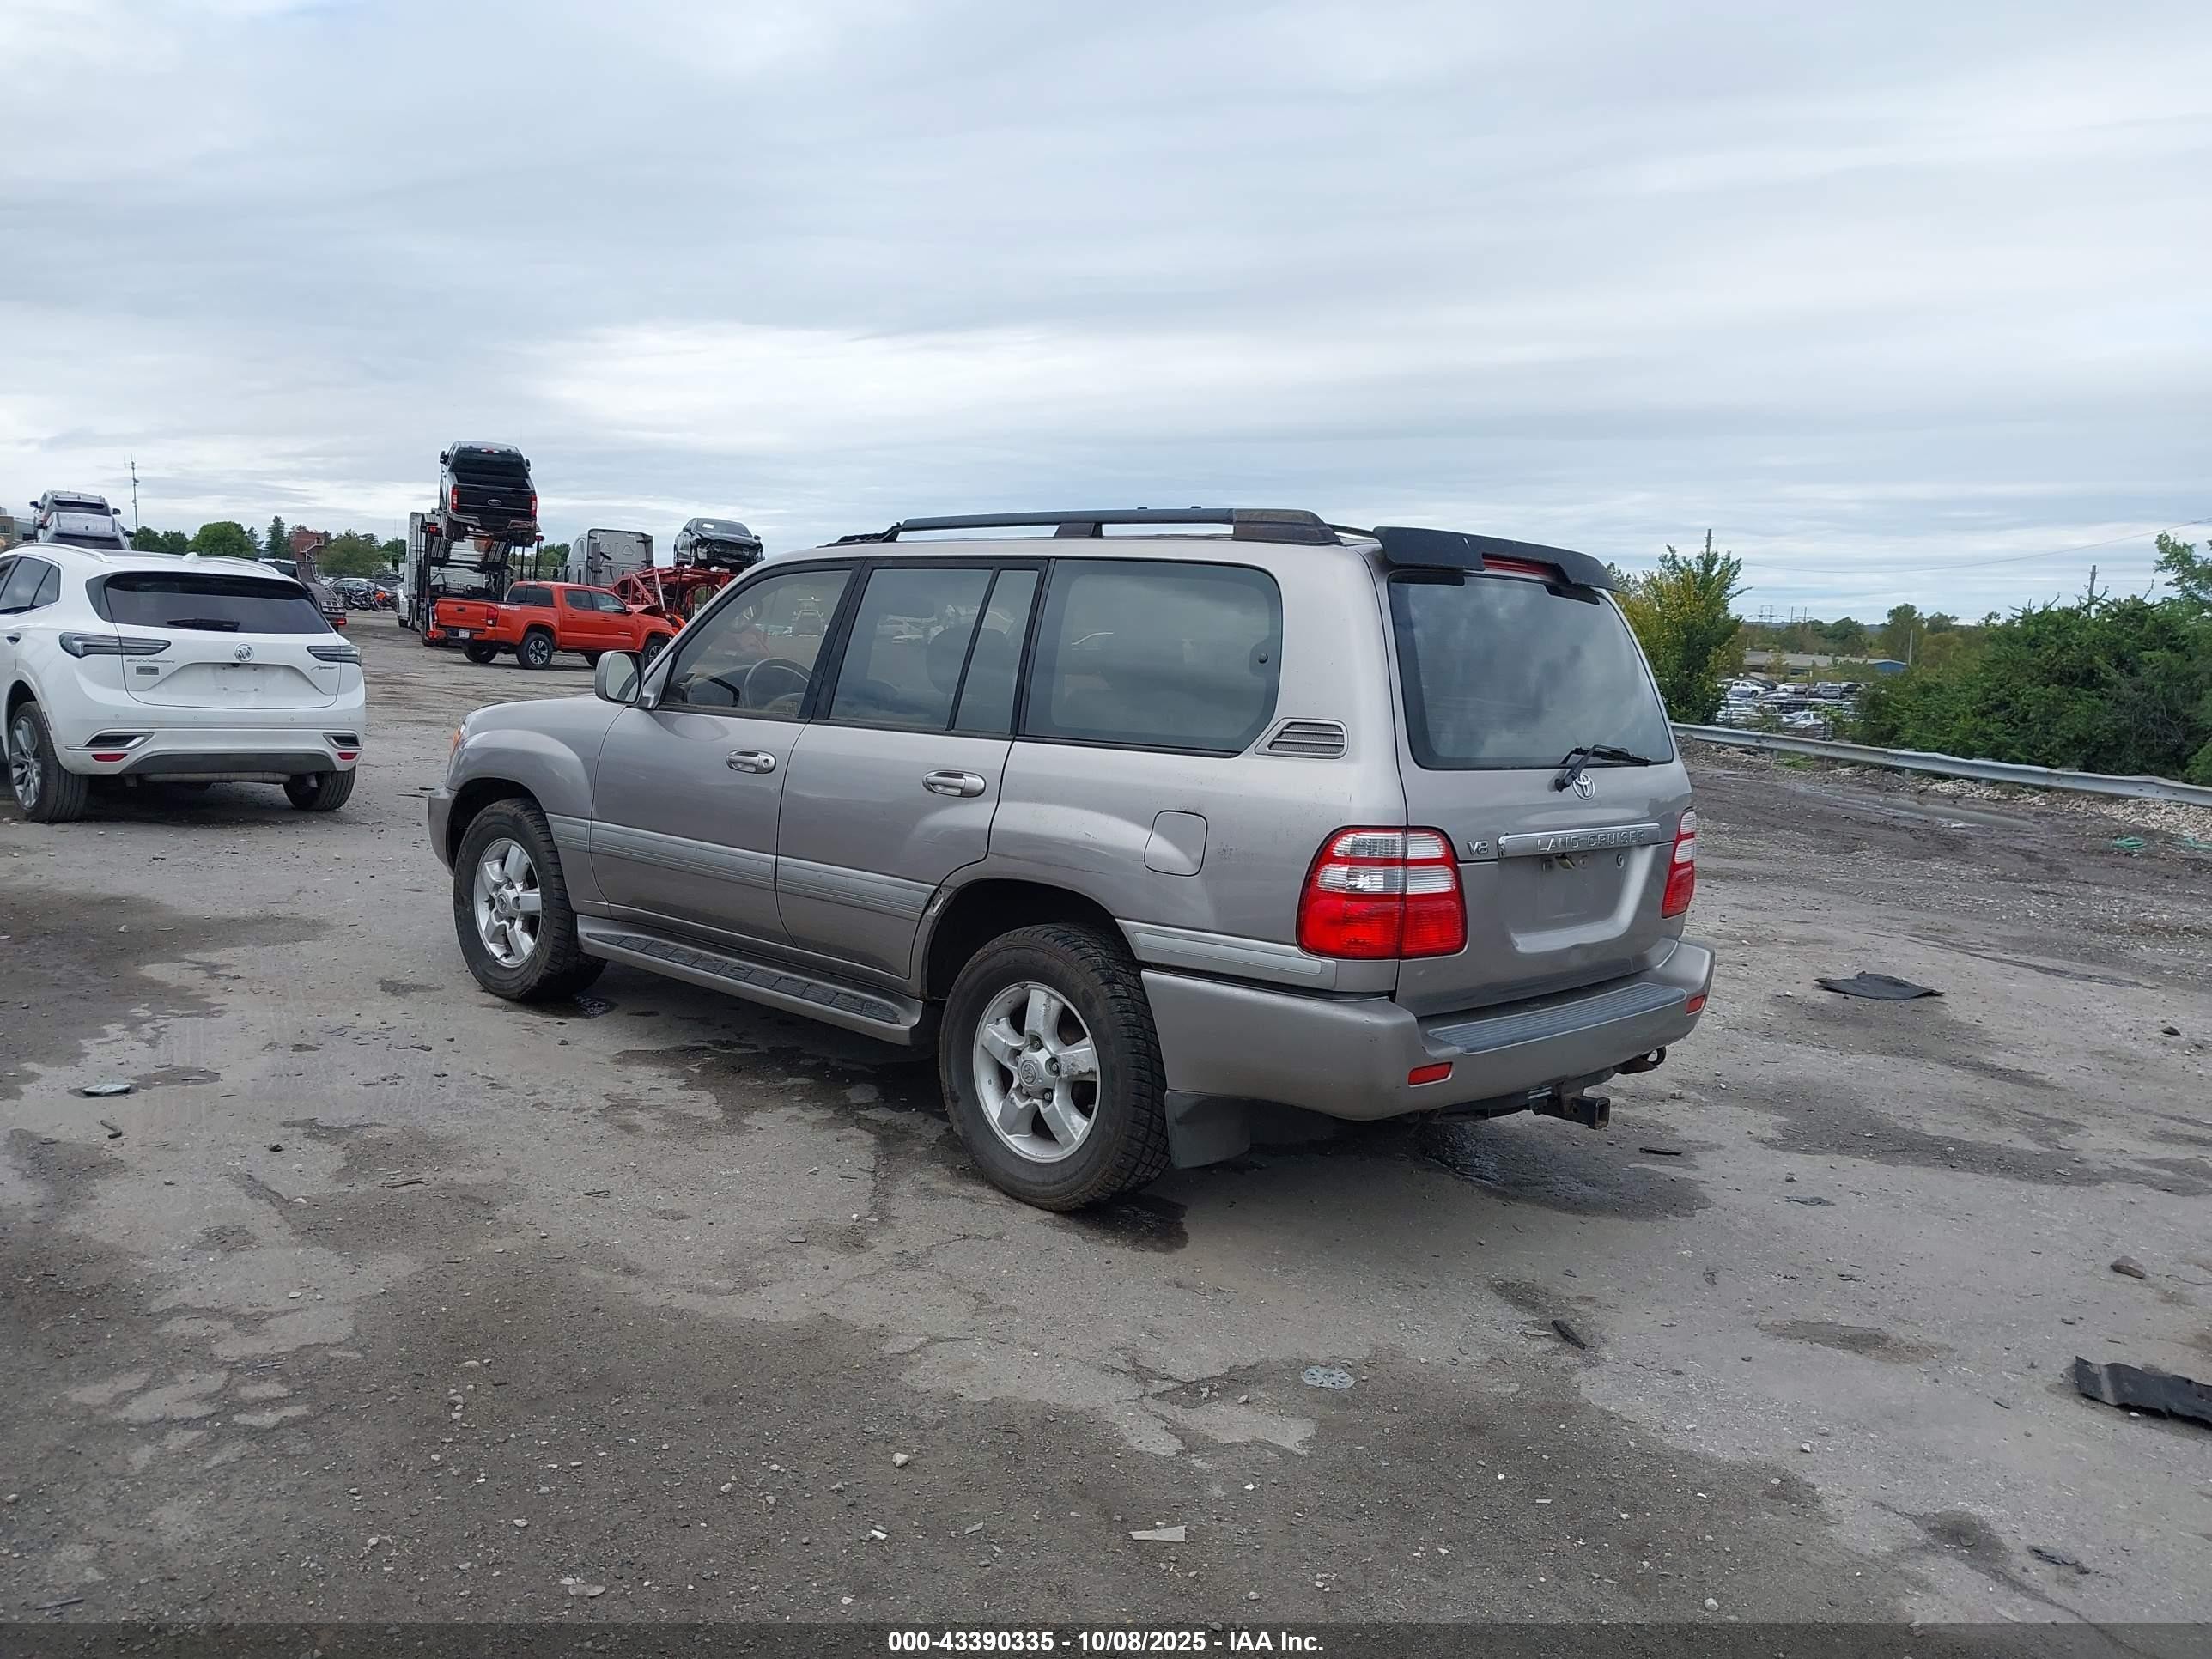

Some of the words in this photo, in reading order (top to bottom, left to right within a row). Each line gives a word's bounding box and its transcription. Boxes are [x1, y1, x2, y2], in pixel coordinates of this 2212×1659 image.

[1467, 840, 1489, 855] V8
[1537, 835, 1580, 852] LAND
[1588, 830, 1644, 847] CRUISER
